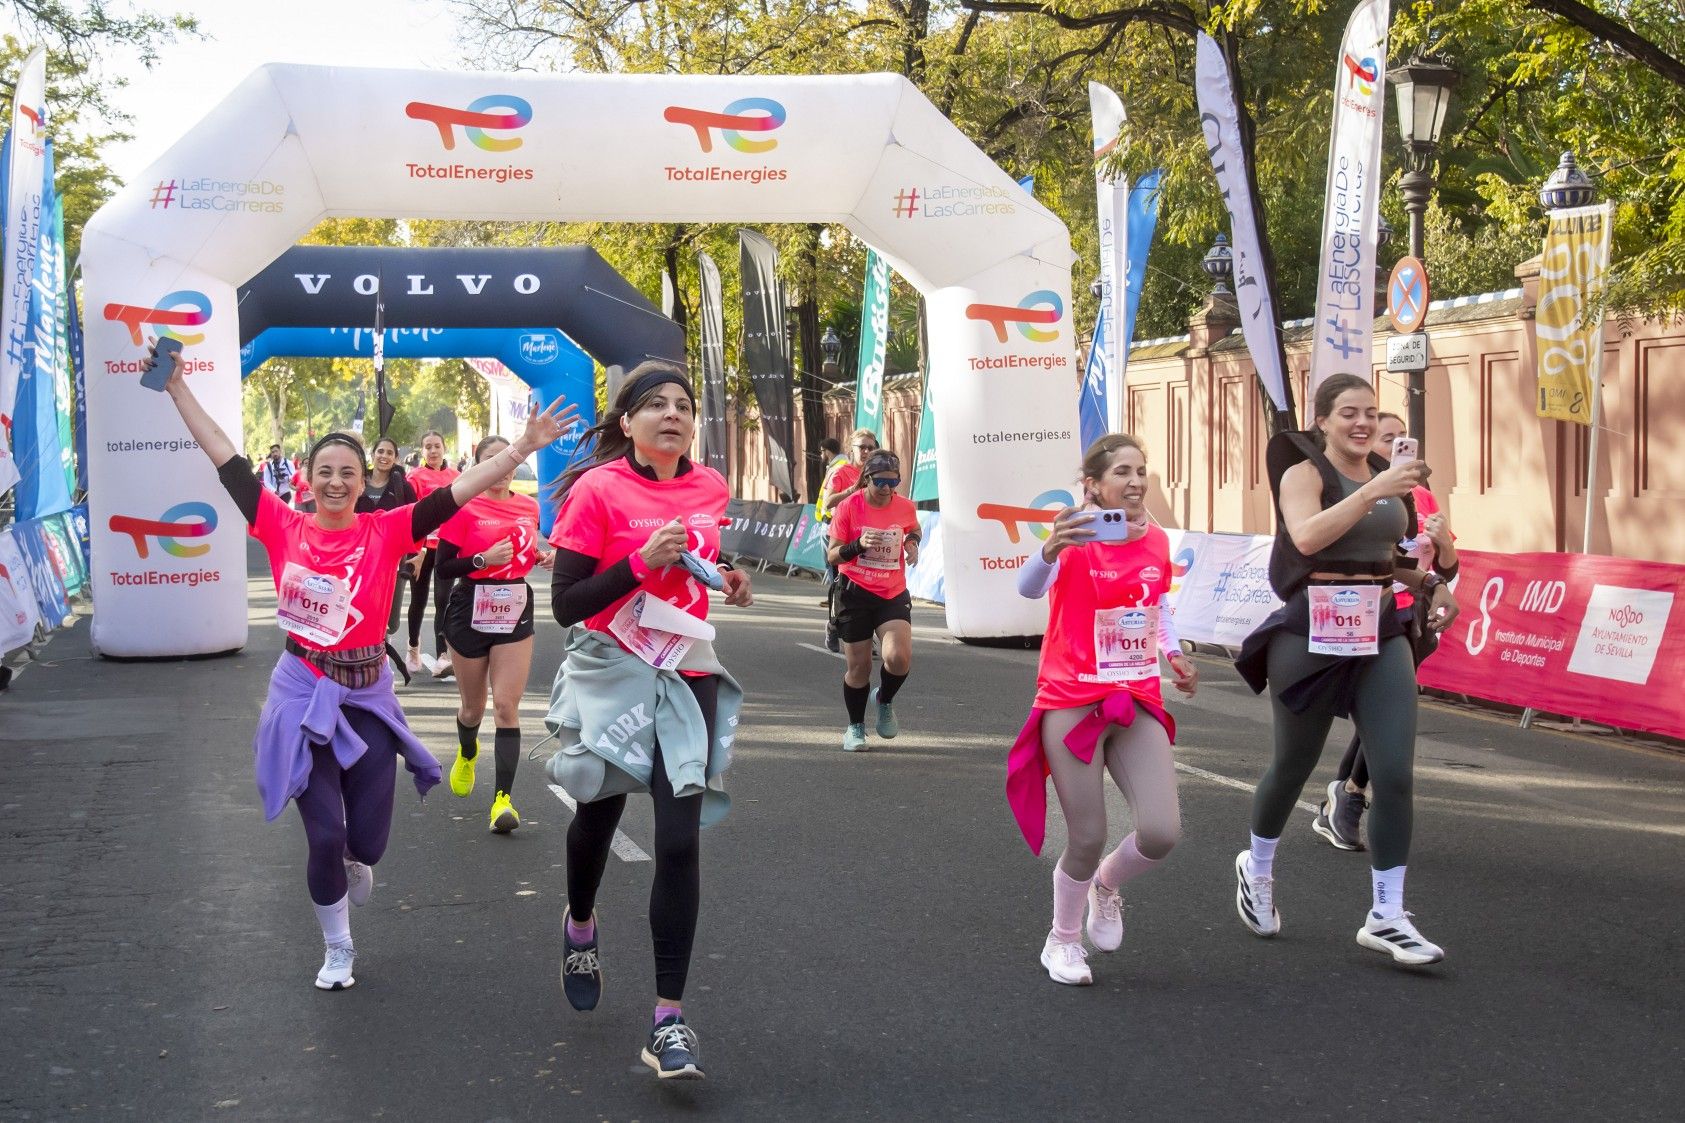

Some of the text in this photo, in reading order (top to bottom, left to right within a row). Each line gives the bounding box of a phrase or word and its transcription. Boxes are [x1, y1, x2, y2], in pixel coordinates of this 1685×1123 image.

[406, 162, 534, 184] TotalEnergies
[664, 165, 787, 184] TotalEnergies
[180, 194, 284, 213] LasCarreras
[923, 201, 1016, 218] LasCarreras
[295, 272, 542, 296] VOLVO
[32, 232, 56, 375] Marlene
[522, 340, 557, 357] Marlene
[1412, 340, 1421, 350] DE
[104, 358, 215, 377] Totalgies
[967, 353, 1067, 371] TotalEnergies
[972, 429, 1072, 445] totalenergies.es
[629, 518, 665, 529] OYSHO
[754, 521, 794, 539] VOLVO
[110, 568, 220, 587] TotalEnergies
[1518, 580, 1566, 614] IMD
[302, 598, 330, 615] 016
[491, 604, 511, 613] 016
[1336, 615, 1361, 627] 016
[1121, 637, 1148, 651] 016
[1494, 628, 1565, 652] Instituto Municipal
[1592, 626, 1649, 647] AYUNTAMIENTO
[1594, 643, 1606, 655] DE
[1500, 649, 1546, 668] de Deportes
[596, 702, 654, 754] YORK
